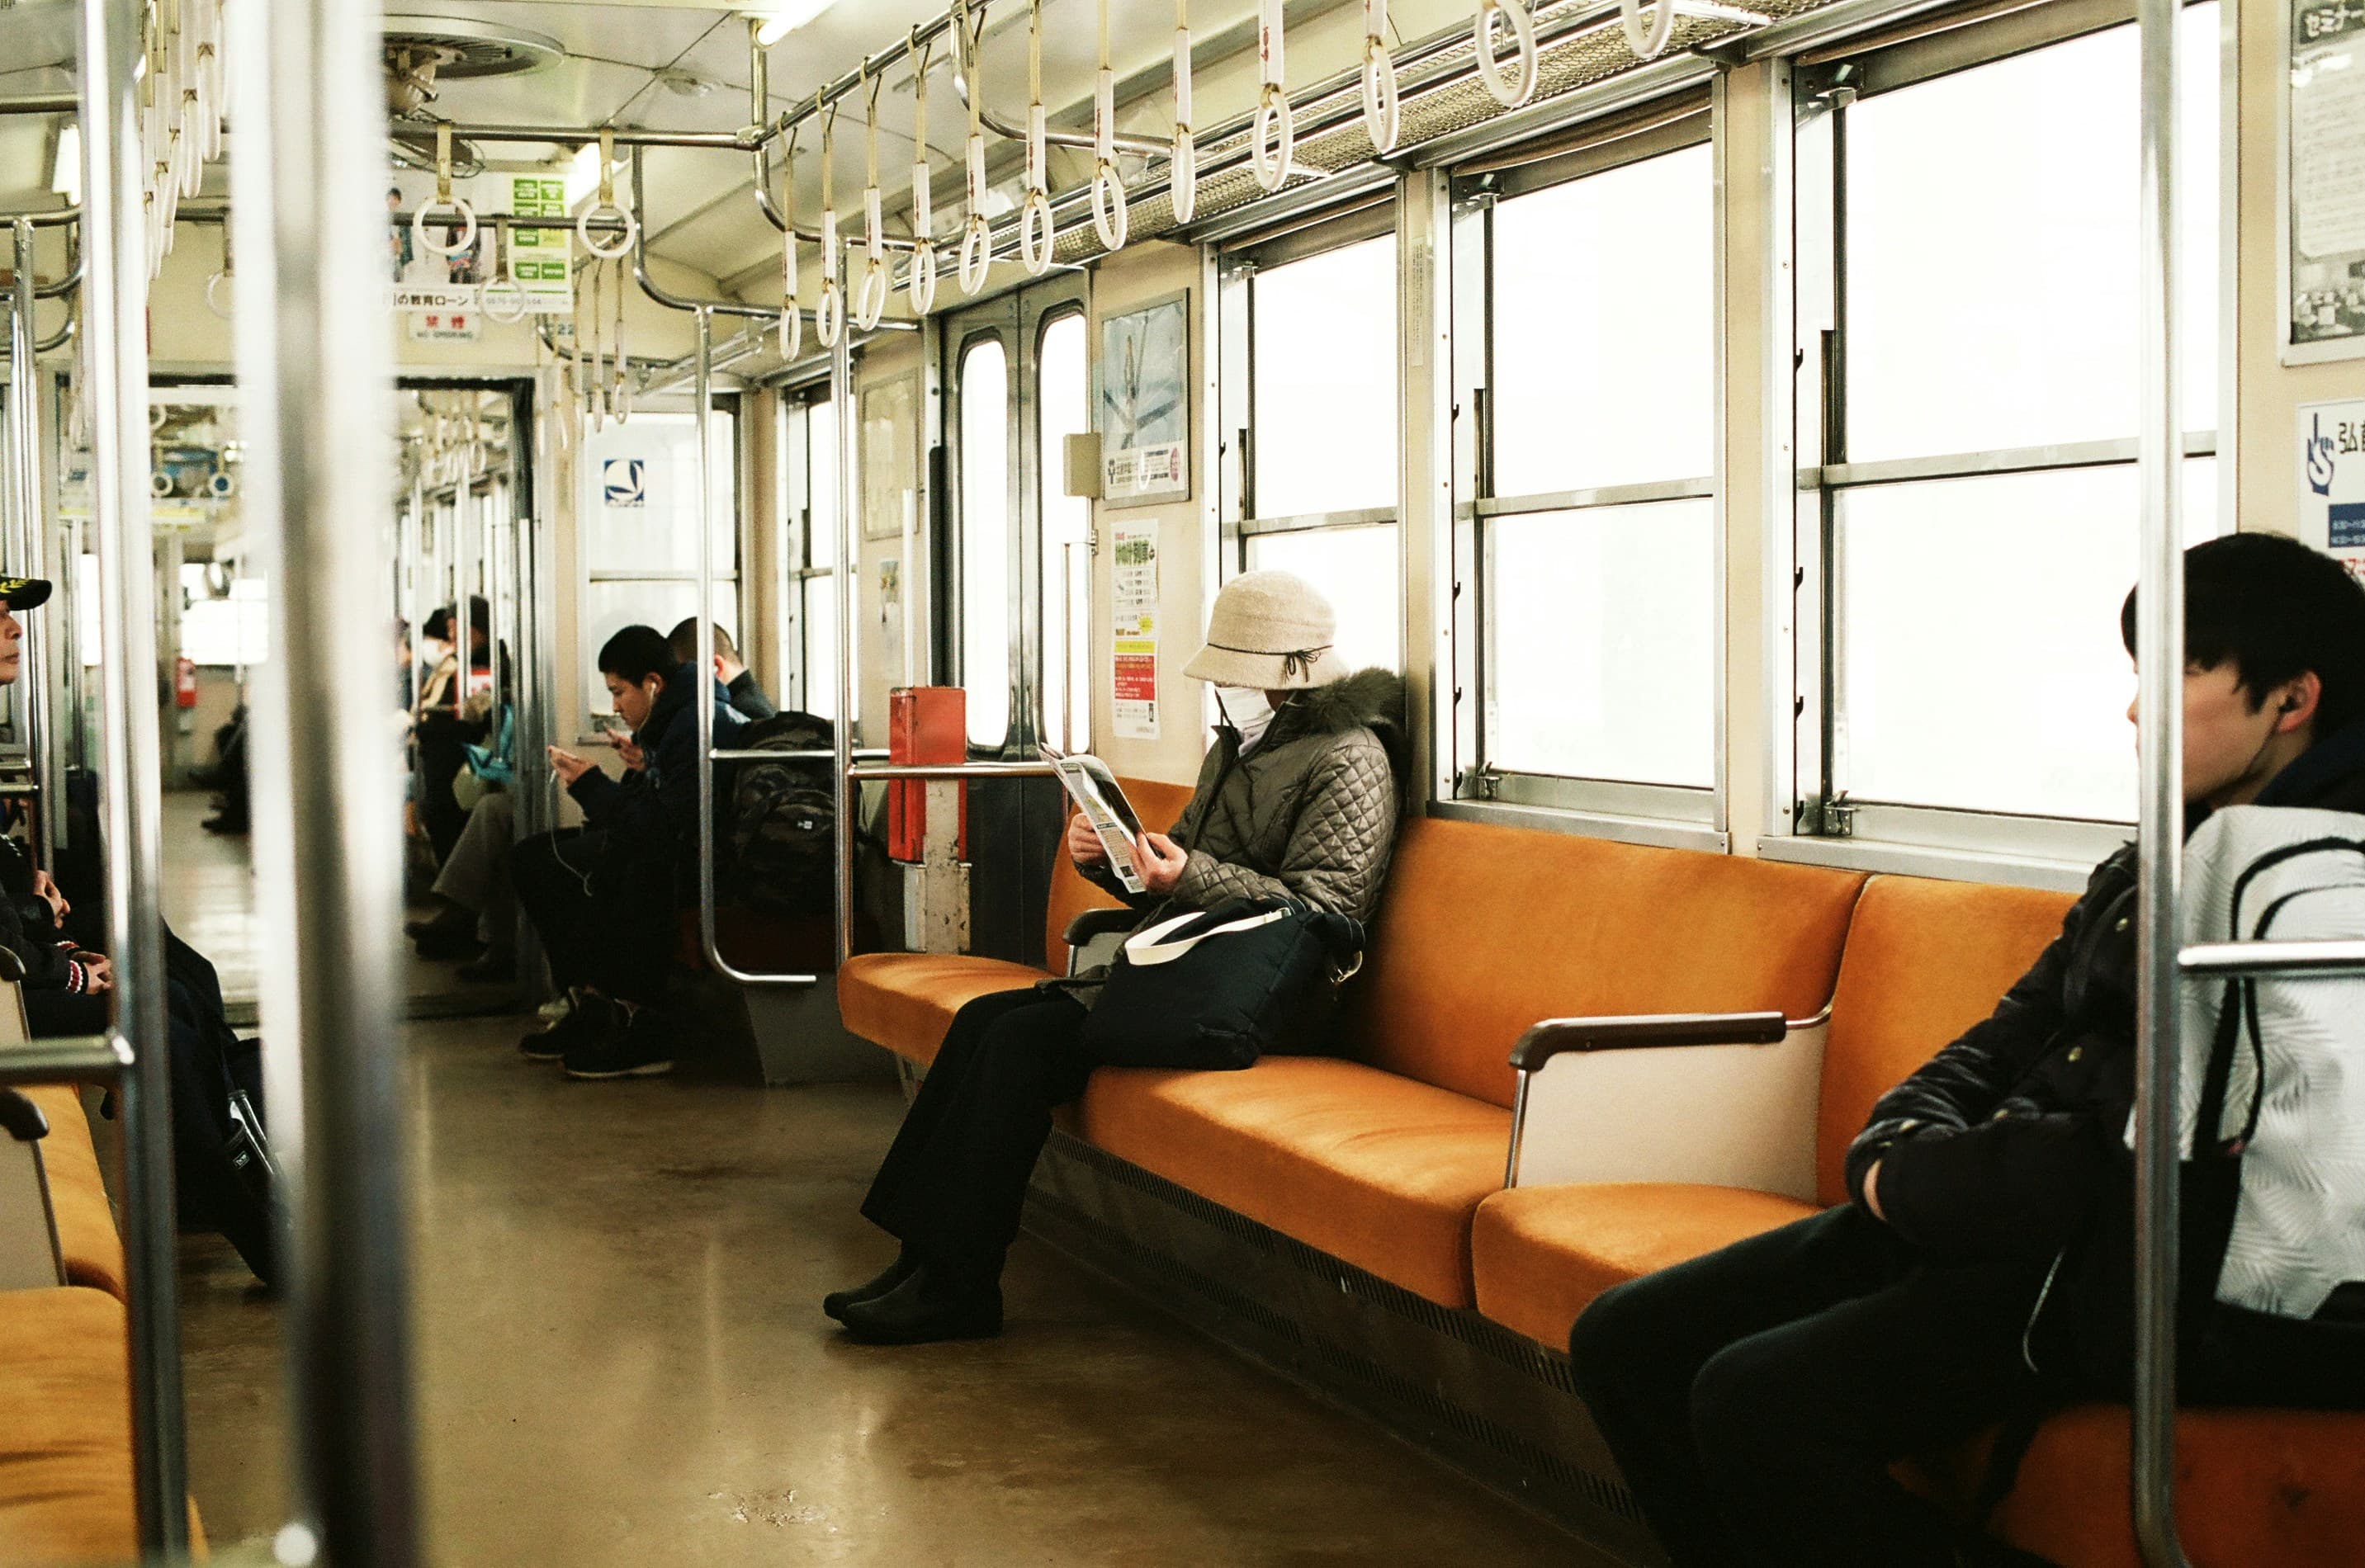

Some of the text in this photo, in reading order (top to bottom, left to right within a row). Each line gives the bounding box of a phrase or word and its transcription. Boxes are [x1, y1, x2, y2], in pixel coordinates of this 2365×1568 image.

[393, 292, 469, 306] の教育ローン
[2339, 422, 2365, 455] 弘
